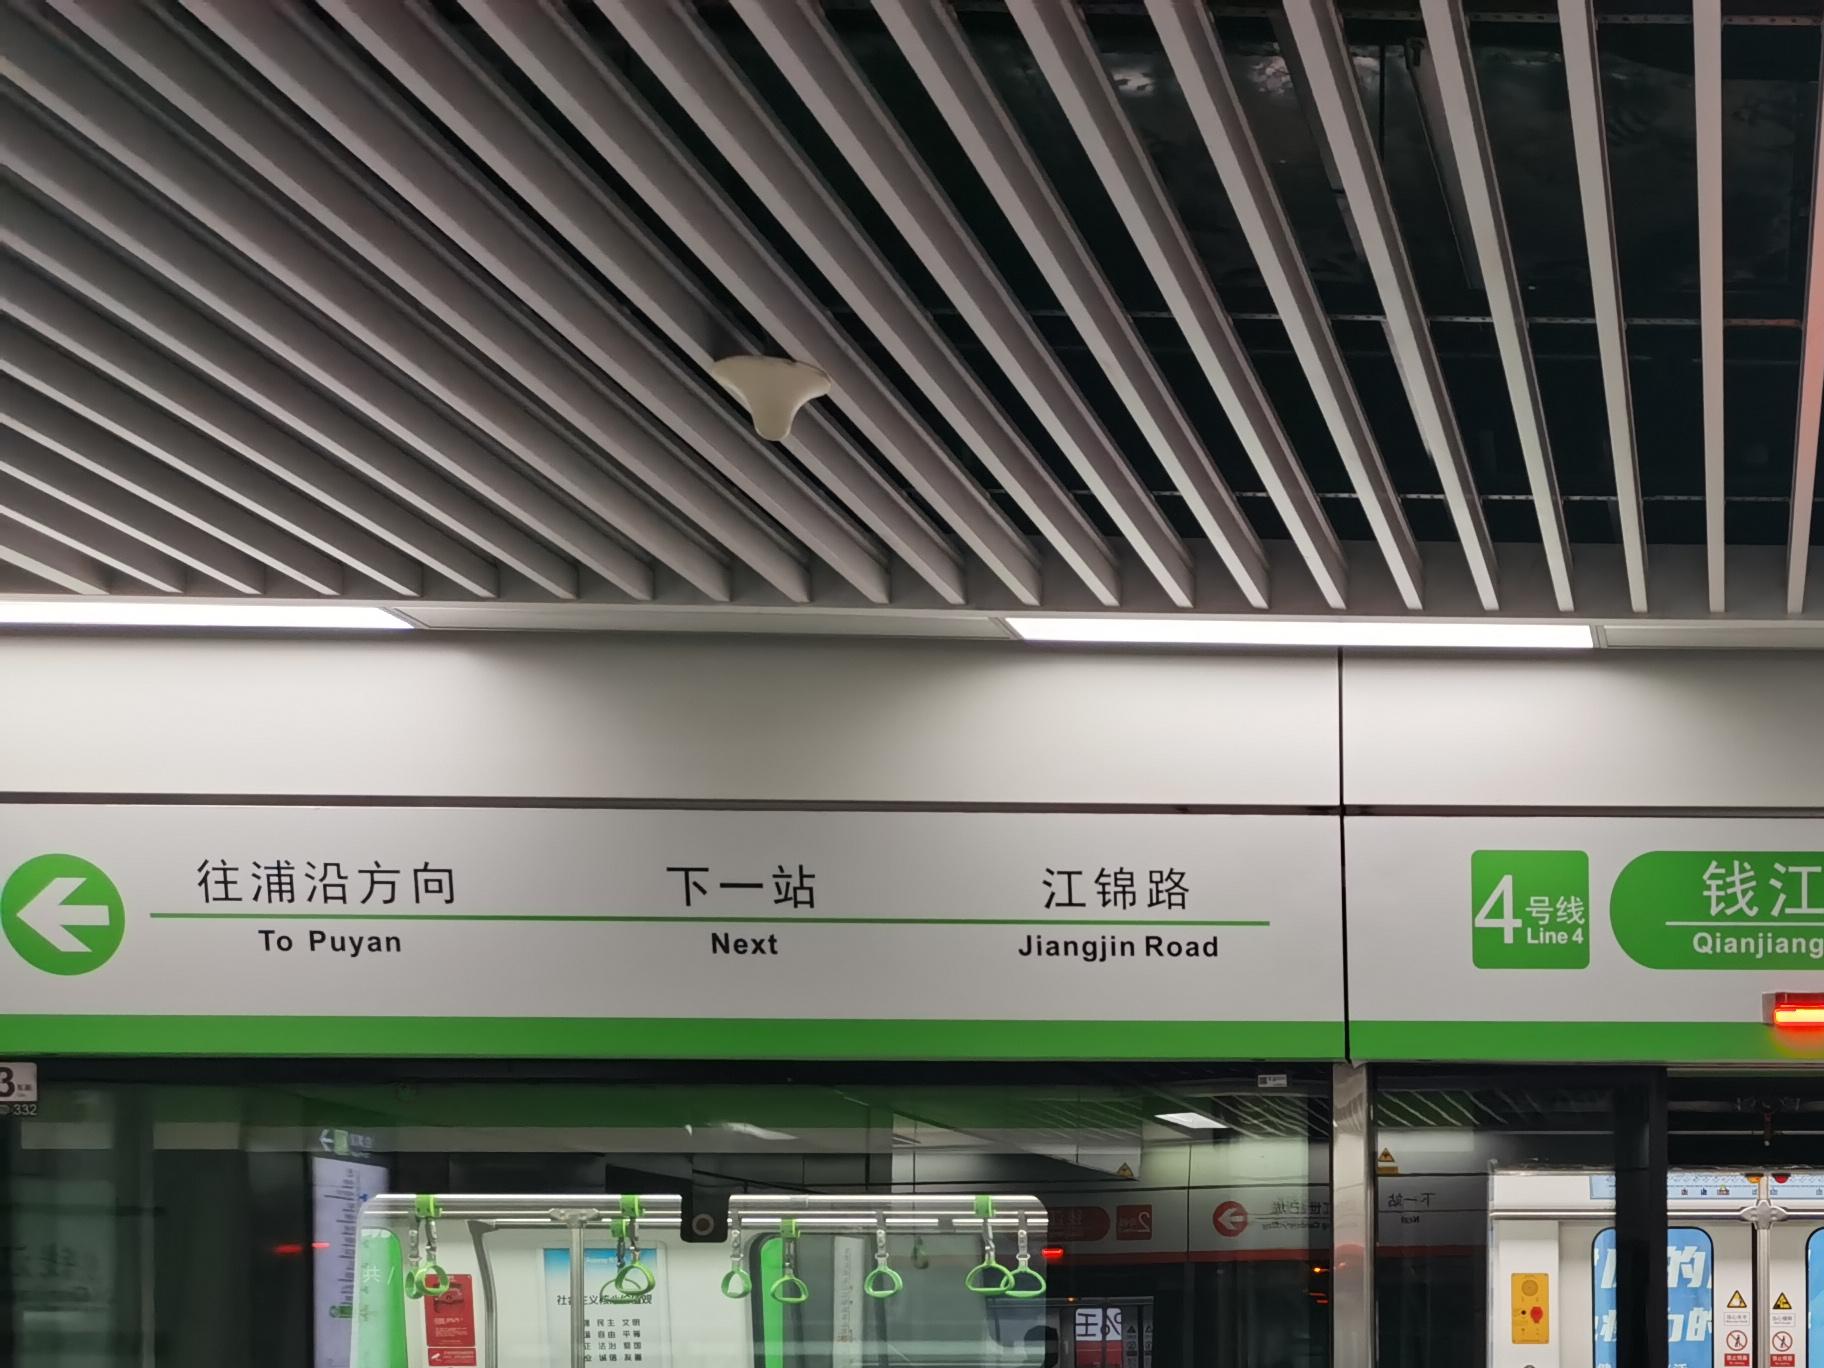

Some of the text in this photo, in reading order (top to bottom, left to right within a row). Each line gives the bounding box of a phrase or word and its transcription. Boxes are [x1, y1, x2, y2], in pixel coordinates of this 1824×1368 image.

[197, 858, 459, 908] 往浦沿方向
[665, 865, 818, 911] 下一站
[1041, 865, 1194, 912] 江锦路
[258, 929, 404, 961] To Puyan
[710, 932, 780, 958] Next
[1017, 932, 1220, 965] Jiangjin Road
[1527, 927, 1584, 946] Line 4
[1693, 932, 1824, 959] Qianjiang
